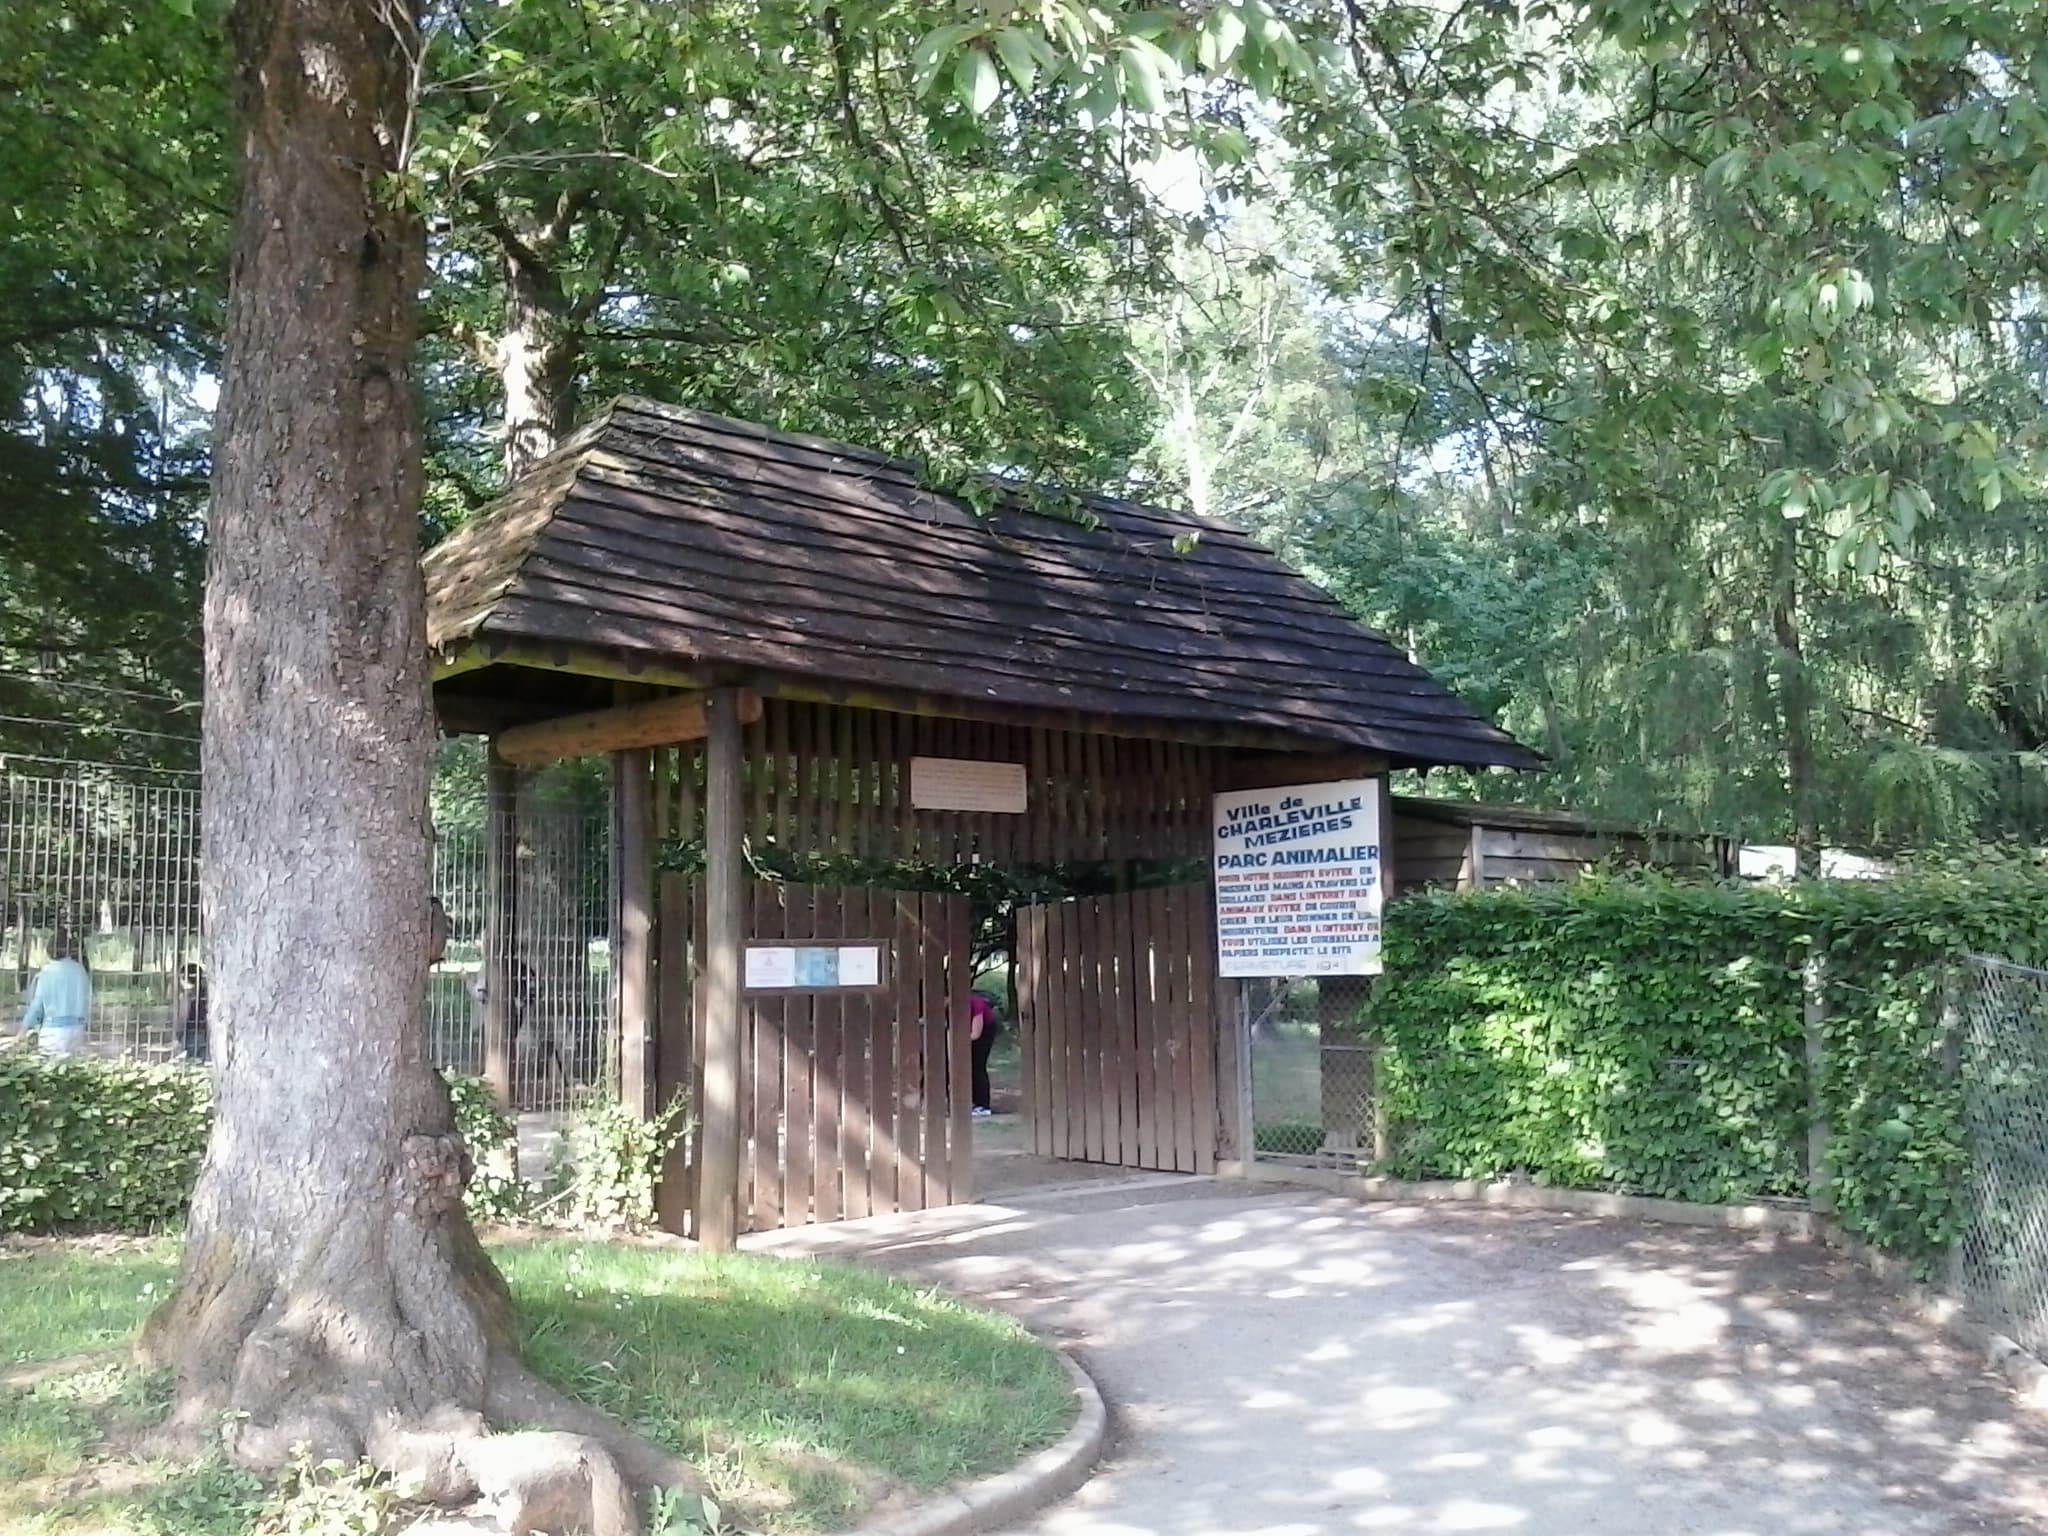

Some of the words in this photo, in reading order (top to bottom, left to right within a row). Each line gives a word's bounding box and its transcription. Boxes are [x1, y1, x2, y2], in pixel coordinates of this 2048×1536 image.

[1217, 796, 1362, 839] CHARLEVILLE
[1227, 803, 1270, 821] Ville
[1280, 796, 1303, 811] de
[1245, 815, 1352, 849] MEZIERES
[1218, 853, 1267, 869] PARC
[1271, 845, 1377, 867] ANIMALIER
